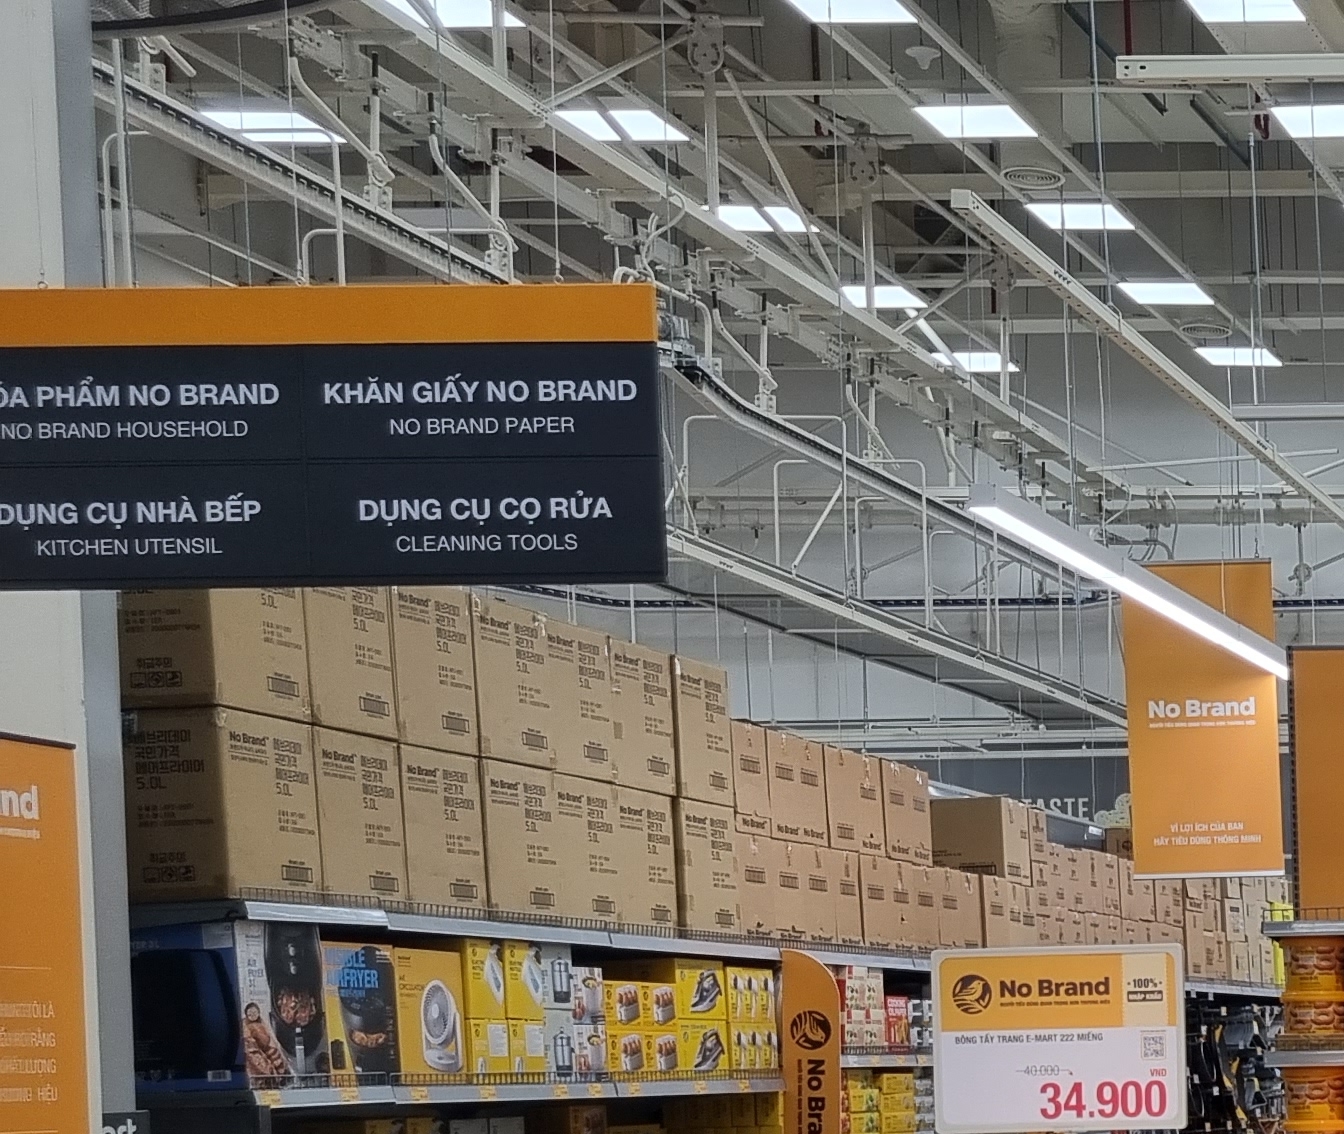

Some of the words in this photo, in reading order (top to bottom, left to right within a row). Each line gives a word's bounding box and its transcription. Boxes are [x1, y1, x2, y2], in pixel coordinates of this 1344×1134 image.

[36, 375, 121, 408] PHẨM
[129, 383, 173, 407] NO
[180, 382, 280, 406] BRAND
[323, 377, 404, 405] KHĂN
[411, 371, 479, 404] GIẤY
[486, 380, 531, 403] NO
[538, 379, 637, 403] BRAND
[1, 423, 32, 440] NO
[38, 422, 111, 440] BRAND
[117, 420, 249, 438] HOUSEHOLD
[389, 418, 420, 435] NO
[426, 418, 499, 435] BRAND
[505, 416, 575, 434] PAPER
[0, 502, 78, 530] DỤNG
[86, 501, 129, 530] CỤ
[136, 490, 197, 524] NHÀ
[205, 490, 262, 523] BẾP
[358, 498, 441, 528] DỤNG
[449, 498, 493, 526] CỤ
[499, 497, 541, 526] CỌ
[548, 488, 612, 521] RỬA
[36, 538, 129, 557] KITCHEN
[134, 536, 223, 555] UTENSIL
[395, 534, 501, 553] CLEANING
[507, 533, 578, 551] TOOLS
[1148, 700, 1181, 719] No
[1185, 696, 1256, 718] Brand
[1000, 979, 1032, 998] No
[1038, 977, 1110, 997] Brand
[1132, 977, 1158, 989] 100%
[955, 1032, 977, 1045] BÔNG
[997, 1033, 1025, 1044] TRANG
[1026, 1033, 1058, 1043] E-MART
[1060, 1033, 1074, 1042] 222
[807, 1059, 825, 1091] No
[1150, 1068, 1167, 1078] VND
[1040, 1080, 1167, 1120] 34.900
